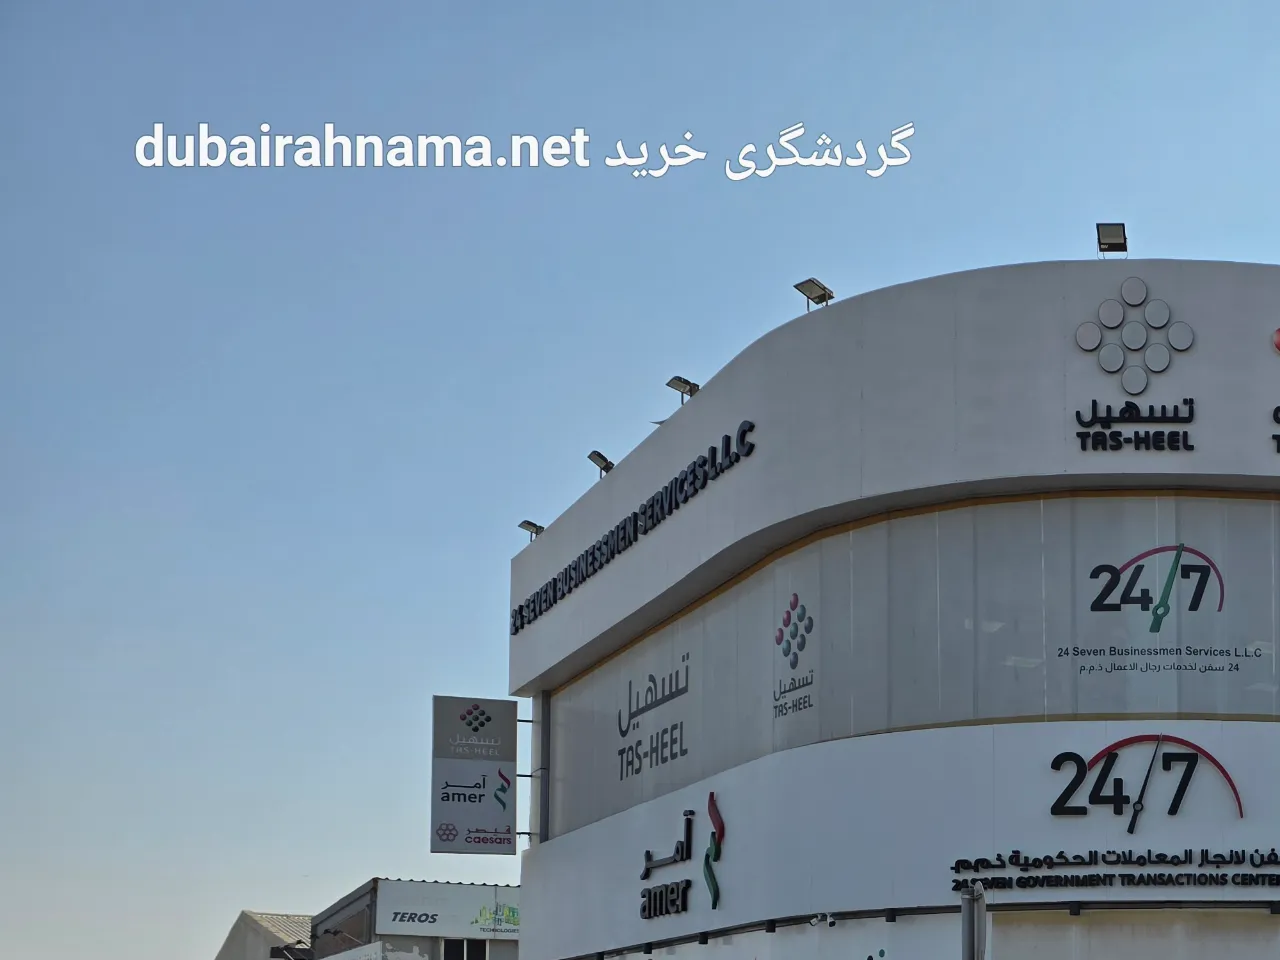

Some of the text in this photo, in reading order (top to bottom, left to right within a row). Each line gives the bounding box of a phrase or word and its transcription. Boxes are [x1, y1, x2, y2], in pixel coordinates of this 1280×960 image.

[1075, 398, 1194, 429] تسهيل
[1075, 431, 1195, 451] TAS-HEEL
[523, 577, 558, 626] SEVEN
[556, 511, 639, 600] BUSINESSMEN
[637, 455, 708, 535] SERVICES
[708, 420, 756, 481] L.L.C
[1057, 645, 1262, 658] 24 Seven Businessmen Services L.L.C
[1228, 662, 1240, 672] 24
[618, 652, 690, 738] تسهيل
[773, 694, 814, 719] TAS-HEEL
[618, 721, 688, 781] TAS-HEEL
[440, 791, 486, 803] amer
[464, 835, 512, 845] caesars
[1016, 873, 1116, 888] GOVERNMENT
[1118, 873, 1228, 887] TRANSACTIONS
[639, 878, 693, 919] amer
[391, 911, 439, 924] TEROS
